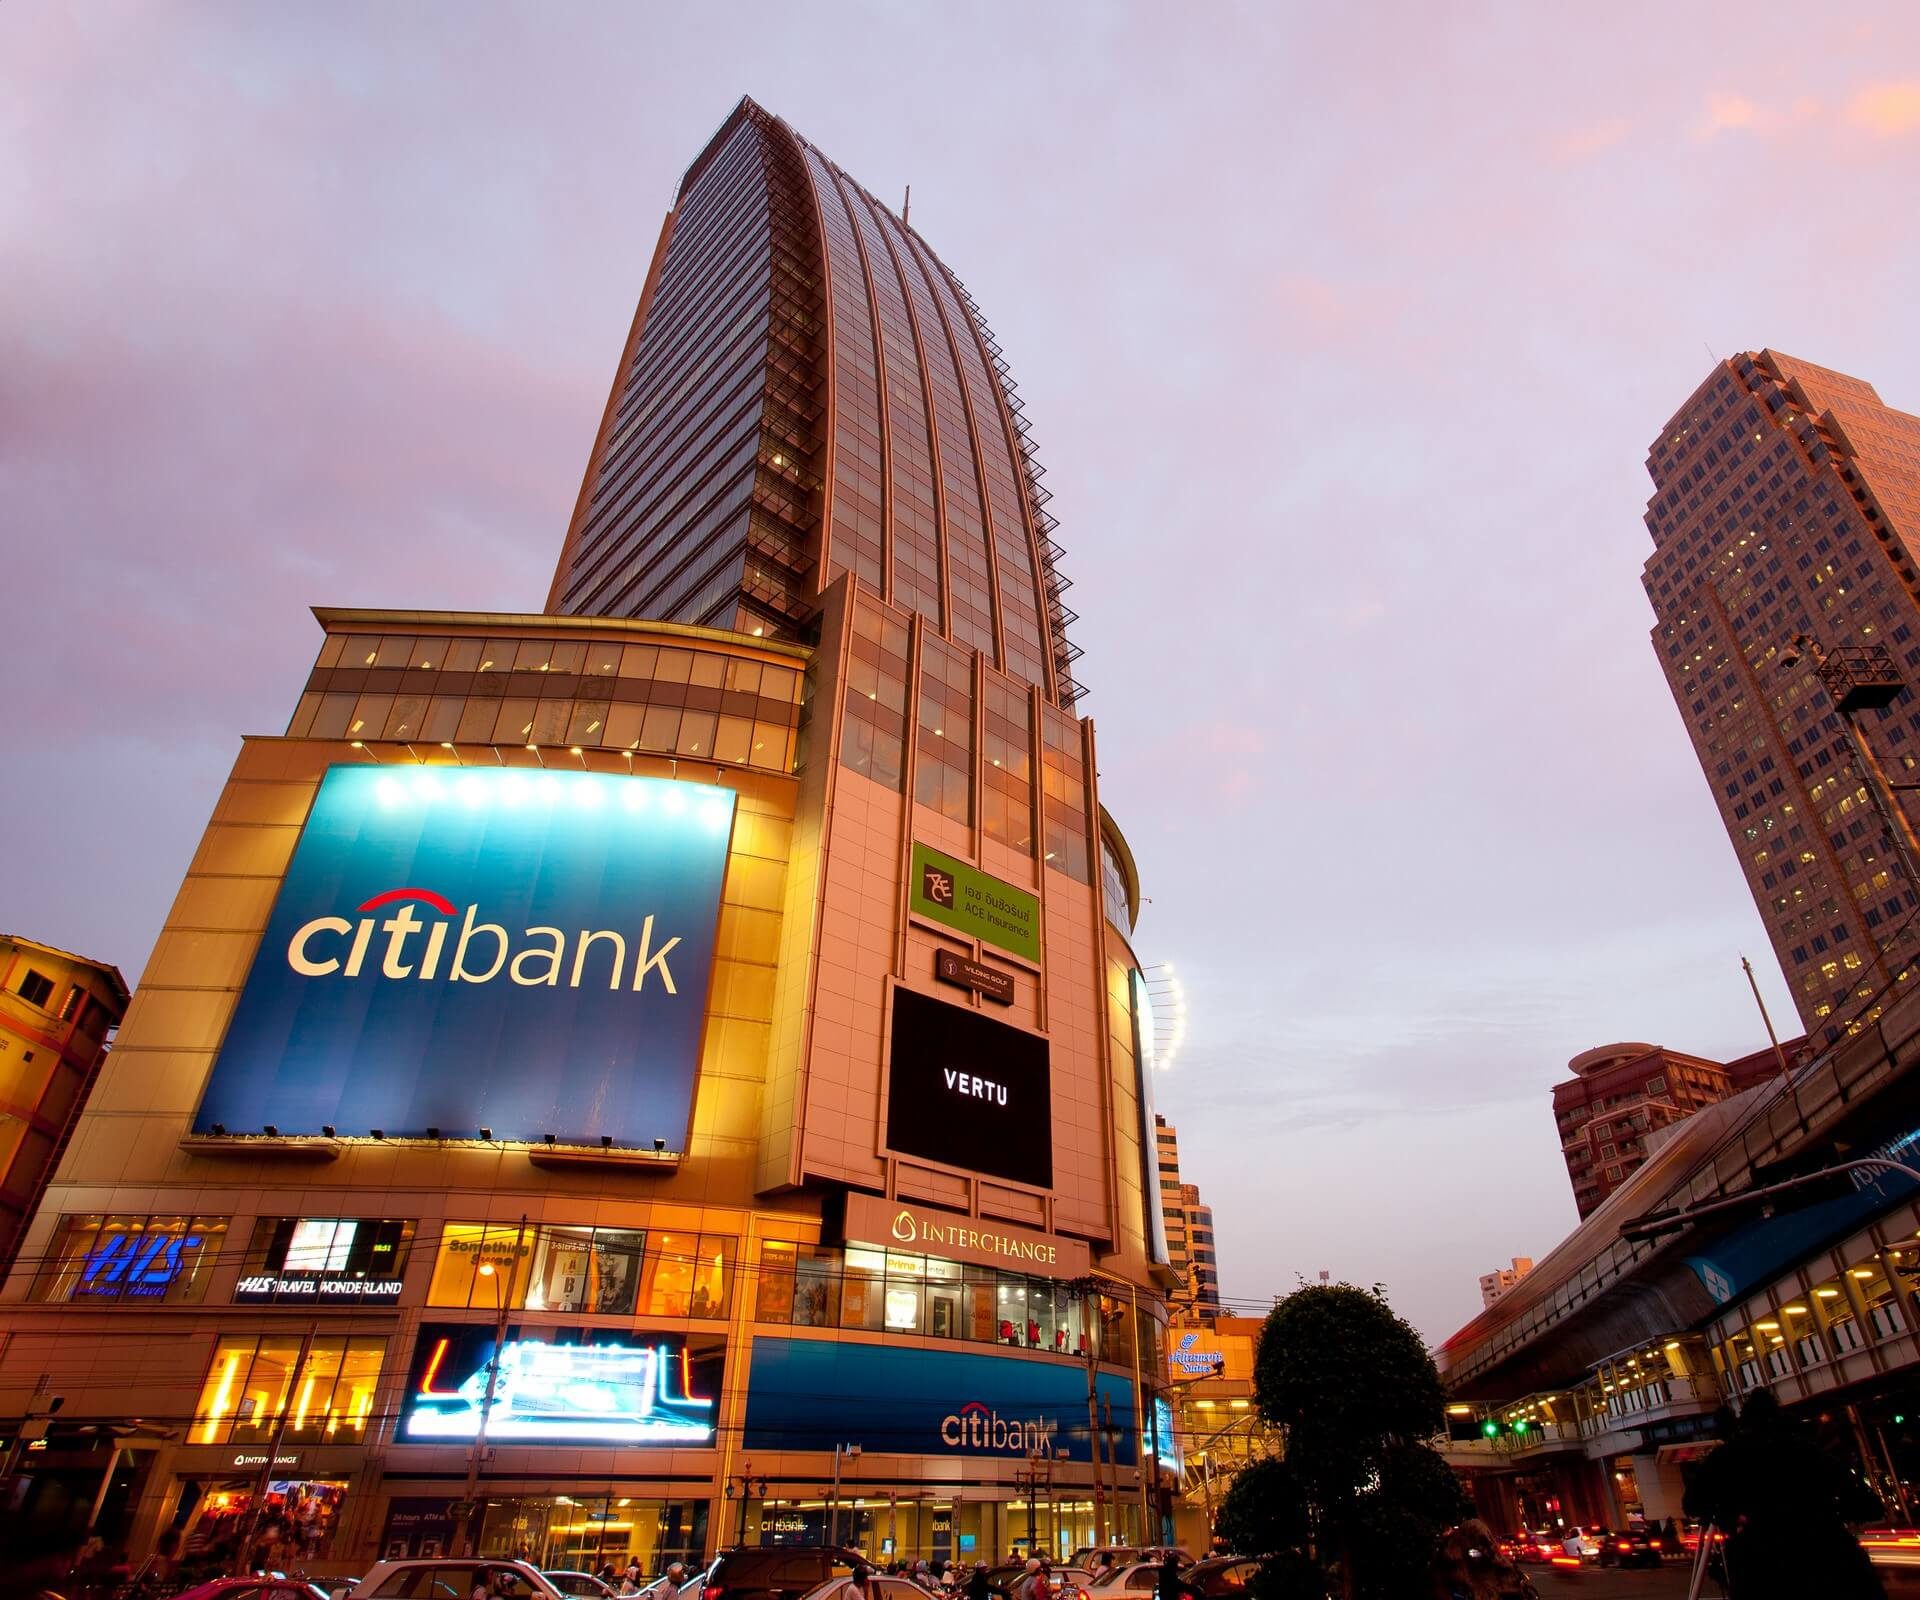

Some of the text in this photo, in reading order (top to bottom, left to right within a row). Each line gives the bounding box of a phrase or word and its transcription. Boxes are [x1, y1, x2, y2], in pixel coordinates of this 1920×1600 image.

[964, 902, 1030, 938] ACE Insurance
[288, 902, 683, 995] citibank
[943, 1067, 1007, 1106] VERTU
[921, 1221, 1056, 1264] INTERCHANGE
[272, 1280, 316, 1294] TRAVEL
[319, 1281, 403, 1295] WONDERLAND
[941, 1410, 1051, 1450] citibank
